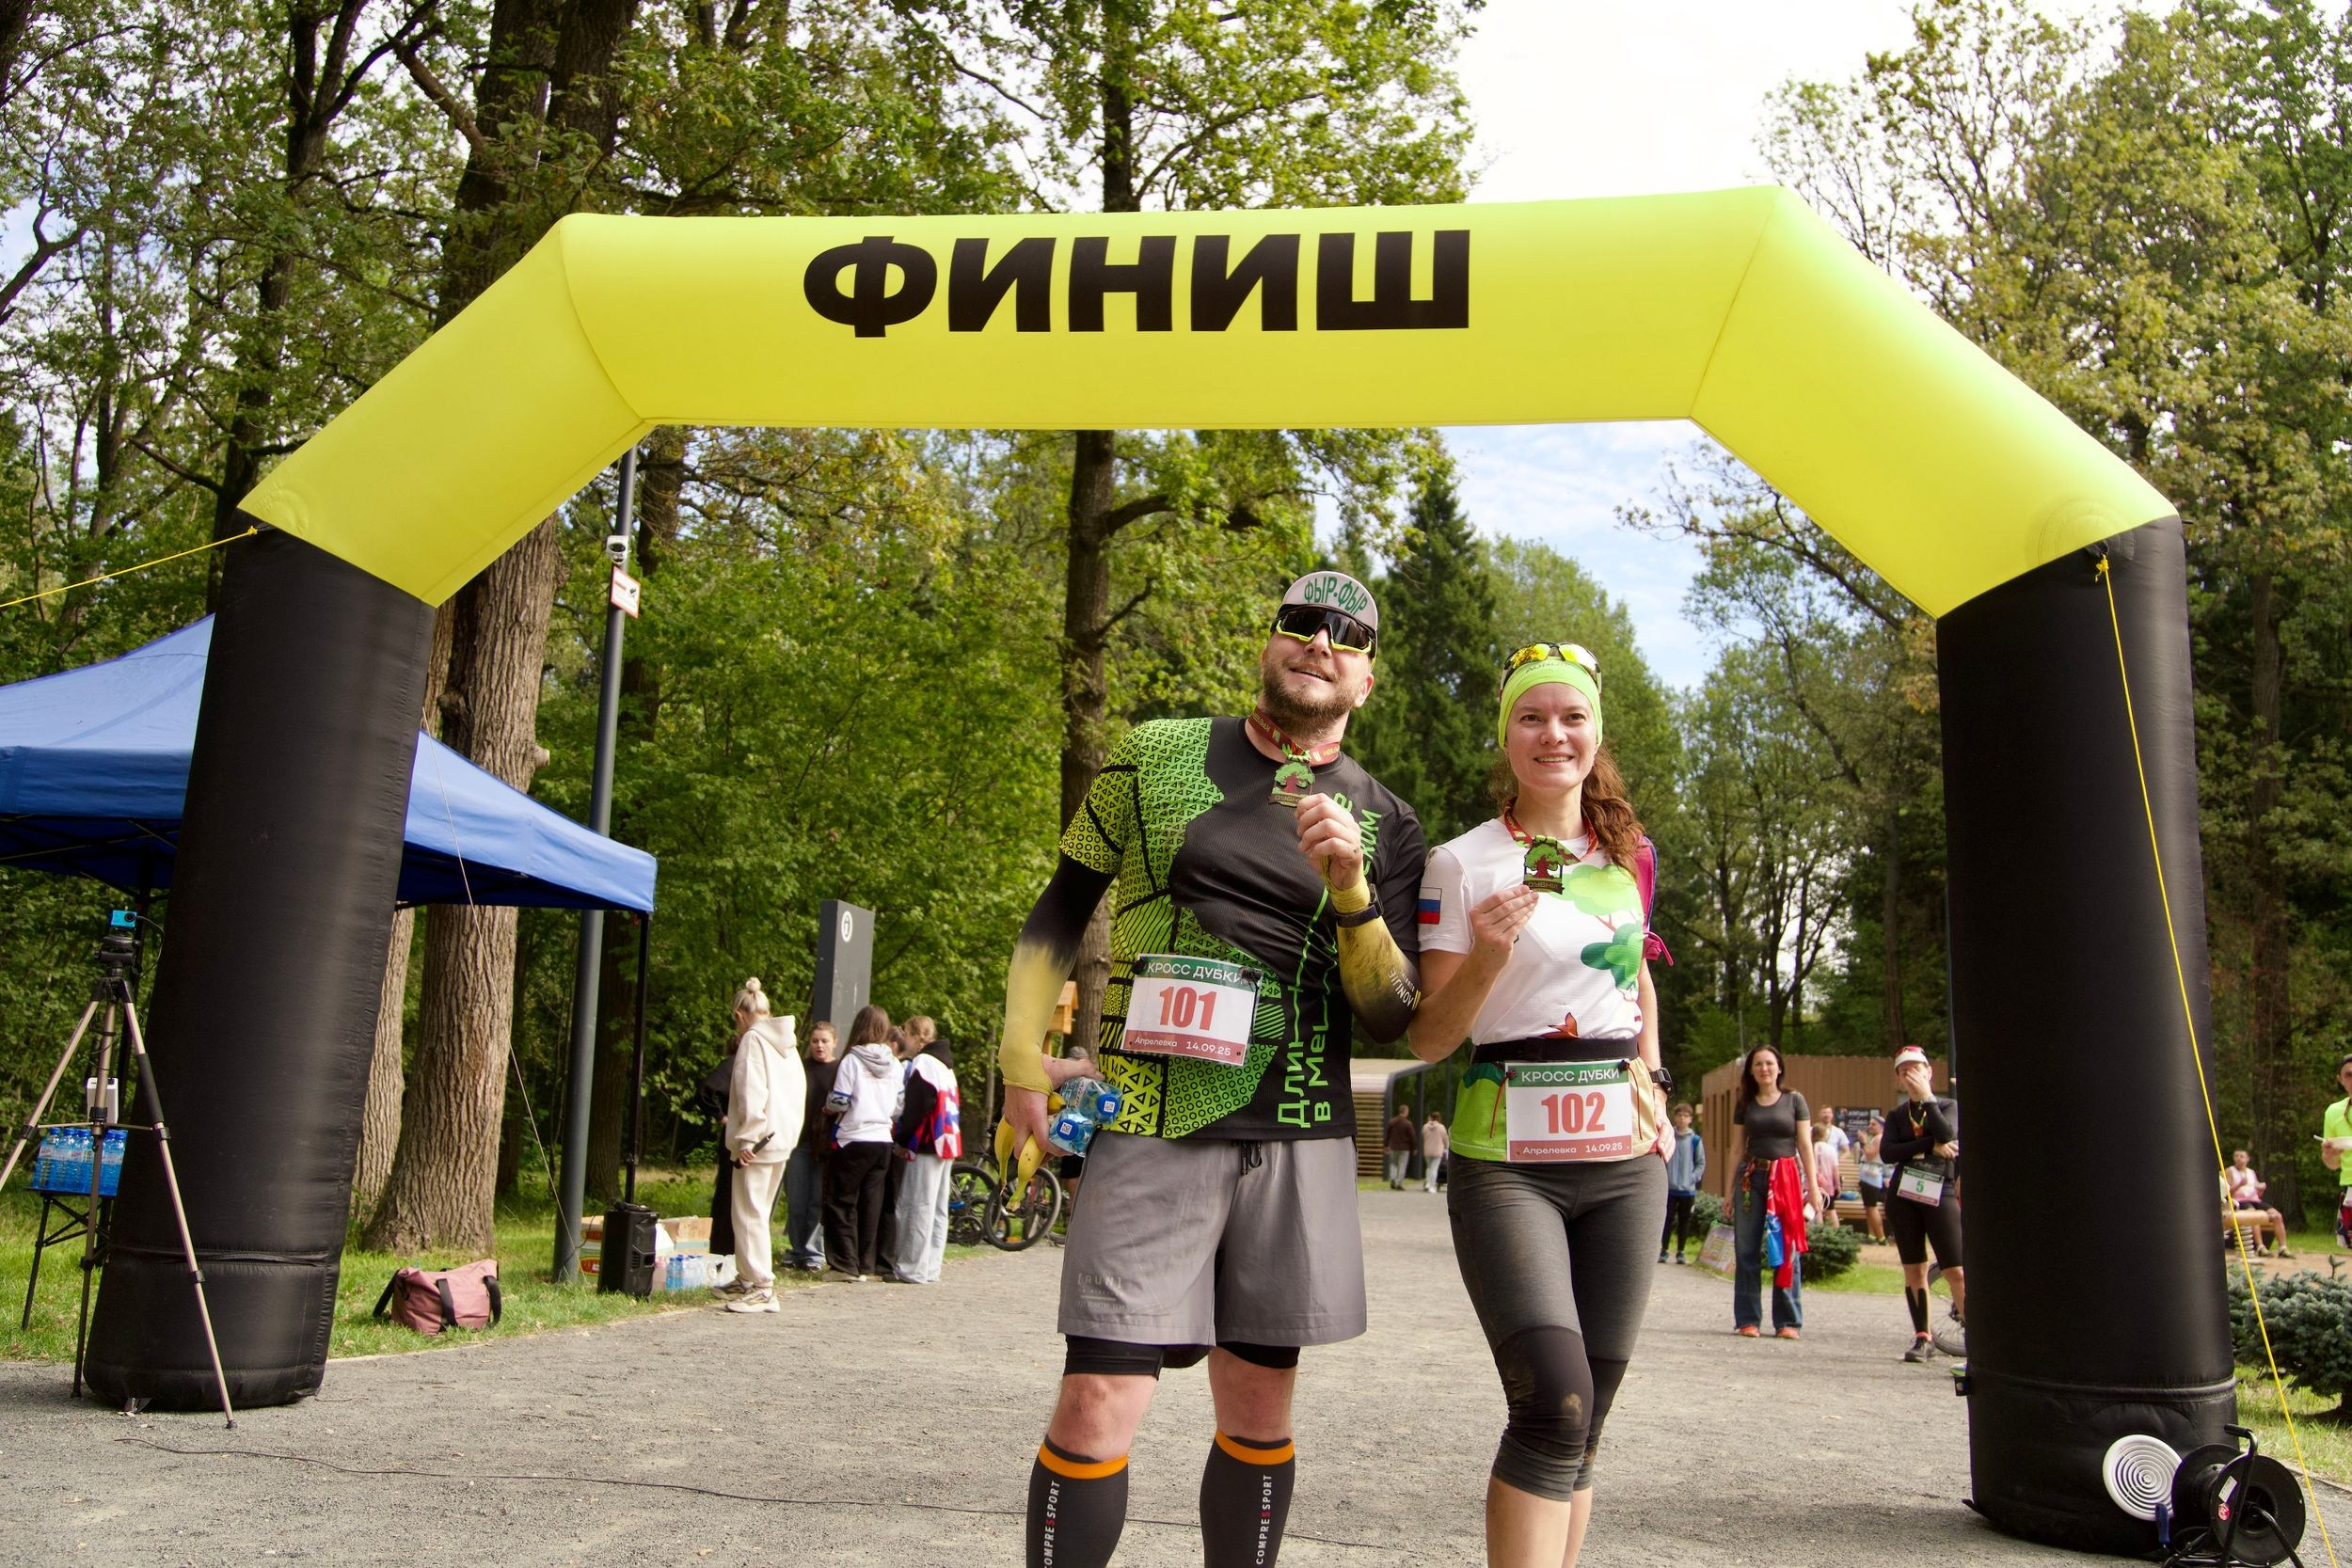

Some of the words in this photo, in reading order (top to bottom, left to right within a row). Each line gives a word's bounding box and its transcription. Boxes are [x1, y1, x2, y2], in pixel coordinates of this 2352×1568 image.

[803, 230, 1470, 338] ФИНИШ
[1304, 577, 1367, 615] ФЫР-ФЫР
[1148, 962, 1191, 975] КРОСС
[1159, 986, 1217, 1031] 101
[1135, 1036, 1178, 1048] Апрелевка
[1186, 1041, 1232, 1056] 14.09.25
[1521, 1070, 1575, 1083] КРОСС
[1578, 1068, 1620, 1084] ДУБКИ
[1541, 1091, 1606, 1134] 102
[1523, 1146, 1577, 1156] Апрелевка
[1585, 1142, 1623, 1153] 14.09.25
[1916, 1180, 1925, 1194] 5
[1255, 1474, 1273, 1566] COMPRESSPORT
